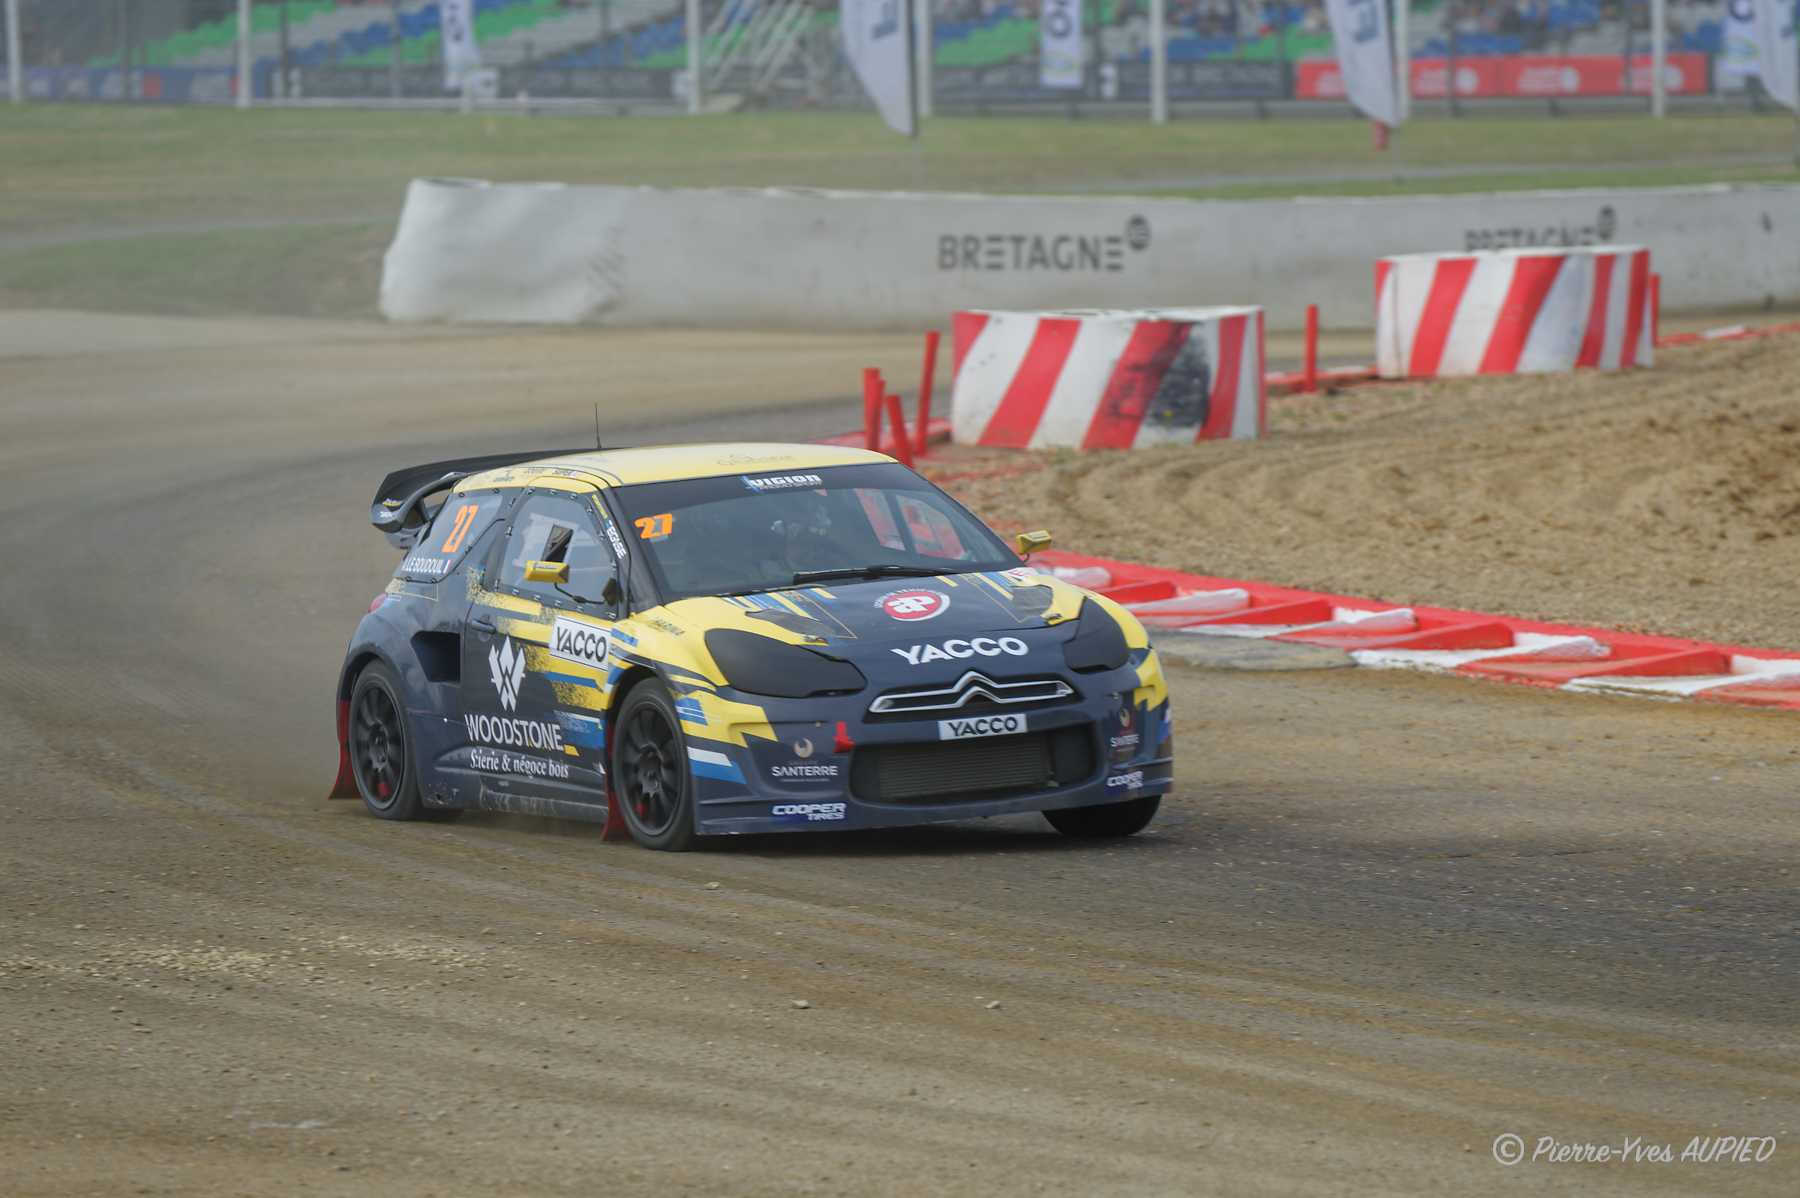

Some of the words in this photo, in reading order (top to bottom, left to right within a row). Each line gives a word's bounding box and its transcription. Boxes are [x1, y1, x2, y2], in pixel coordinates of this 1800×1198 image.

[938, 235, 1124, 271] BRETAGNE
[441, 504, 479, 553] 27
[634, 513, 673, 539] 27
[556, 626, 607, 662] YACCO
[890, 637, 1029, 665] YACCO
[464, 713, 564, 751] WOODSTONE
[948, 716, 1018, 737] YACCO
[501, 754, 511, 772] &
[513, 755, 547, 779] négoce
[549, 758, 569, 778] bois
[771, 765, 839, 777] SANTERRE
[772, 802, 847, 816] COOPER
